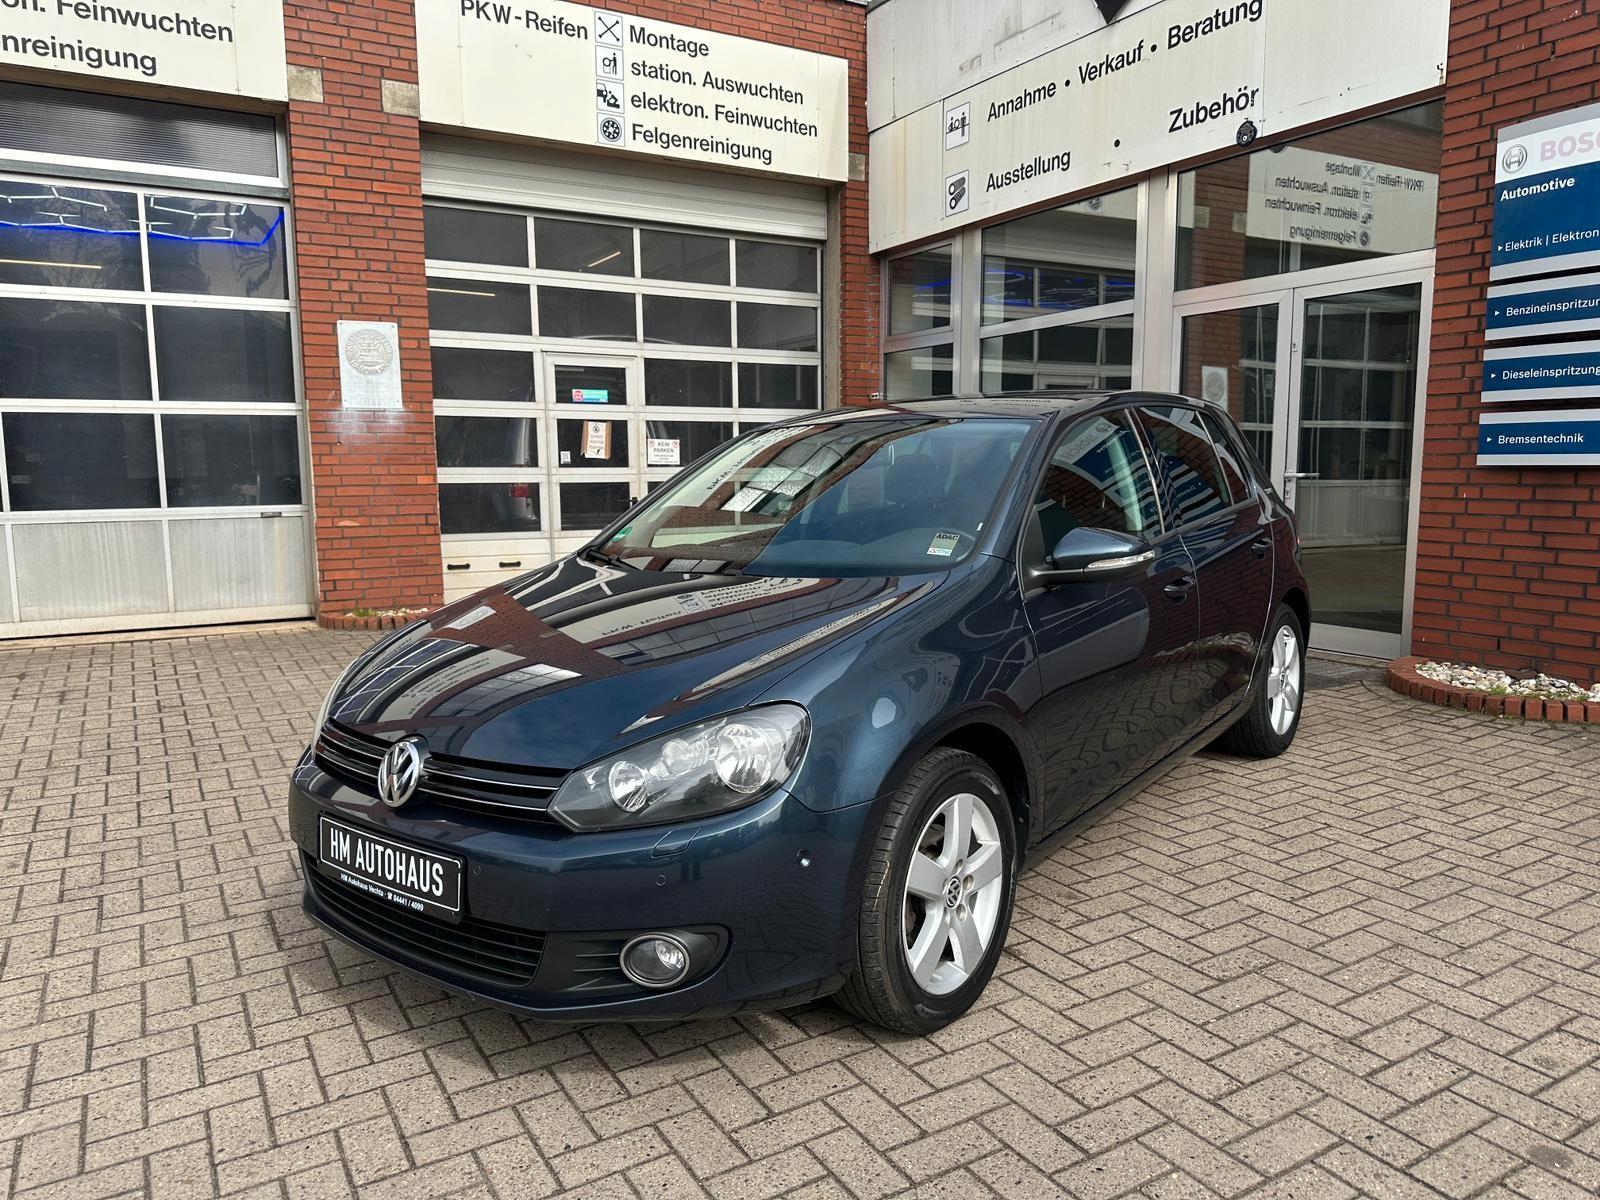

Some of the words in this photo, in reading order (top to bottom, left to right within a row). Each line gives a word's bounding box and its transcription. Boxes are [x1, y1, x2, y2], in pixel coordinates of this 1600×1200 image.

[57, 0, 233, 43] Feinwuchten
[461, 0, 588, 40] PKW-Reifen
[2, 34, 157, 77] nreinigung
[629, 25, 710, 58] Montage
[987, 81, 1057, 122] Annahme
[1078, 39, 1144, 85] Verkauf
[1168, 0, 1262, 50] Beratung
[631, 61, 697, 86] station.
[702, 73, 804, 105] Auswuchten
[631, 91, 709, 120] elektron.
[714, 104, 818, 138] Feinwuchten
[1168, 86, 1259, 133] Zubehör
[631, 124, 773, 165] Felgenreinigung
[1540, 130, 1600, 162] BOS
[986, 151, 1071, 193] Ausstellung
[1500, 177, 1576, 201] Automotive
[1505, 236, 1542, 251] Elektrik
[1552, 229, 1600, 244] Elektron
[1502, 365, 1600, 380] Dieseleinspritzung
[1498, 433, 1584, 444] Bremsentechnik
[330, 828, 350, 864] HM
[355, 838, 443, 896] AUTOHAUS
[347, 877, 368, 890] Autohaus
[411, 901, 424, 912] 4099
